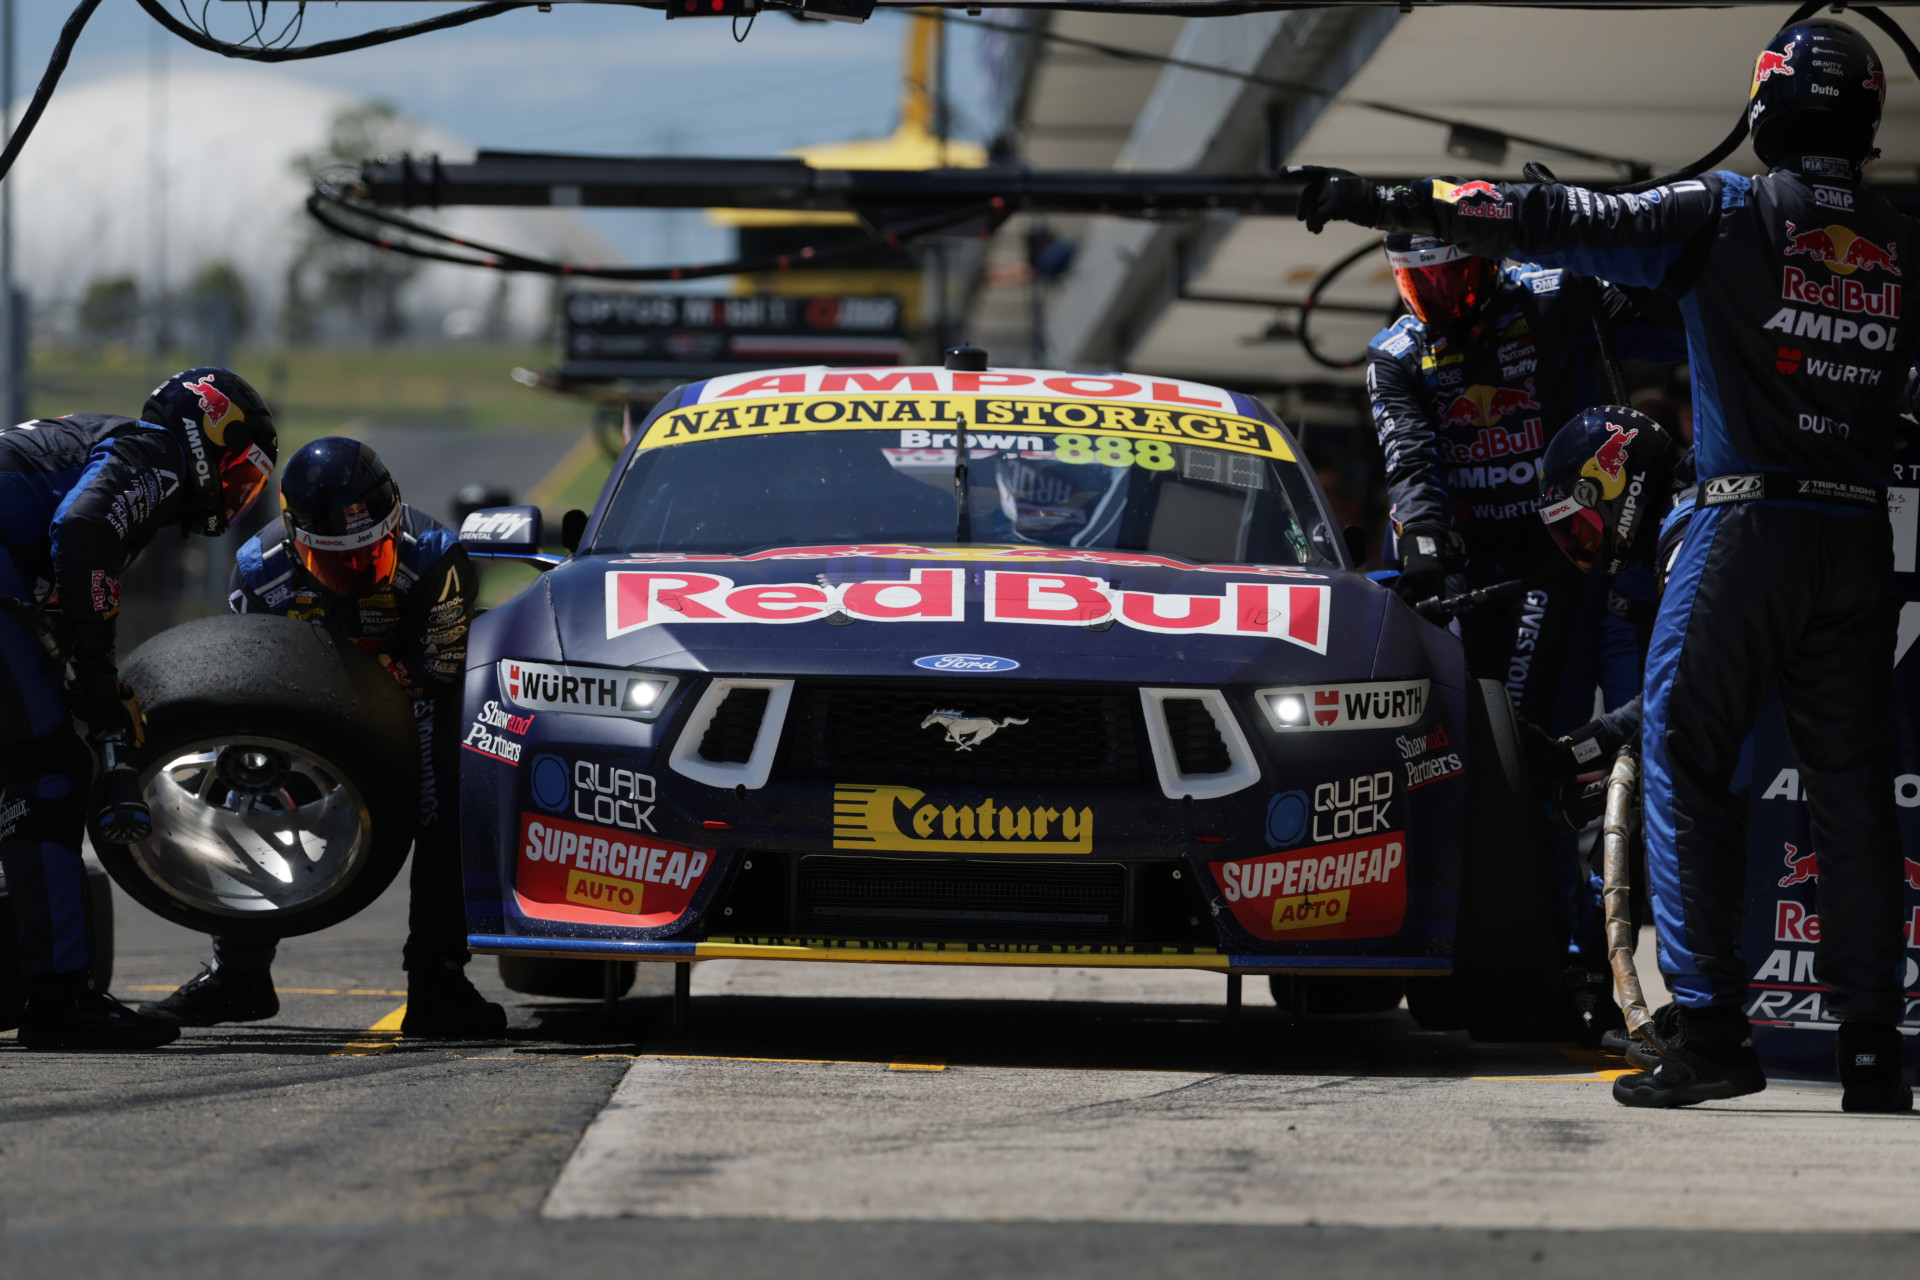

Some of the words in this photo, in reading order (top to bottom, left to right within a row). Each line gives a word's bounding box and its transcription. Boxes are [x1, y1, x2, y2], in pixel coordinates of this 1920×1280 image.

[1812, 60, 1842, 71] GRAVITY
[1823, 67, 1844, 77] MEDIA
[1811, 83, 1840, 97] Dutto
[1458, 201, 1486, 217] Red
[1486, 203, 1514, 219] Bull
[1814, 188, 1854, 208] OMP
[1420, 254, 1436, 262] Dan
[1533, 277, 1559, 292] OMP
[1782, 266, 1840, 310] Red
[1843, 279, 1901, 320] Bull
[1763, 307, 1897, 352] AMPOL
[1502, 359, 1539, 378] Thrifty
[715, 371, 1223, 408] AMPOL
[664, 400, 964, 438] NATIONAL
[987, 401, 1261, 449] STORAGE
[1439, 429, 1490, 464] Red
[1488, 417, 1544, 458] Bull
[182, 417, 210, 487] AMPOL
[900, 430, 1044, 451] Brown
[1055, 433, 1176, 471] 888
[1617, 471, 1647, 539] AMPOL
[1706, 494, 1739, 504] MECHANIX
[1740, 490, 1763, 500] WEAR
[1812, 480, 1848, 490] TRIPLE
[1850, 485, 1877, 497] EIGHT
[1812, 488, 1833, 496] RACE
[207, 515, 219, 531] Toby
[345, 518, 374, 531] AMPOL
[1548, 505, 1571, 518] AMPOL
[357, 531, 373, 543] Joel
[462, 532, 492, 540] RENTAL
[91, 569, 105, 593] Red
[265, 586, 289, 606] OMP
[430, 595, 464, 613] AMPOL
[607, 569, 964, 638] Red
[985, 570, 1329, 654] Bull
[1516, 589, 1549, 652] GIVES
[932, 655, 998, 671] Ford
[1505, 655, 1533, 698] YOU
[522, 671, 617, 708] WÜRTH
[1345, 686, 1422, 721] WÜRTH
[478, 700, 510, 730] Shaw
[507, 714, 534, 736] and
[463, 722, 522, 763] Partners
[1395, 734, 1427, 759] Shaw
[574, 760, 656, 803] QUAD
[1404, 752, 1464, 787] Partners
[1314, 771, 1394, 812] QUAD
[574, 789, 658, 833] LOCK
[833, 783, 1093, 854] Century
[1312, 800, 1392, 842] LOCK
[525, 821, 708, 890] SUPERCHEAP
[1222, 841, 1403, 902] SUPERCHEAP
[573, 879, 635, 906] AUTO
[1278, 898, 1341, 924] AUTO
[1775, 900, 1822, 943] Re
